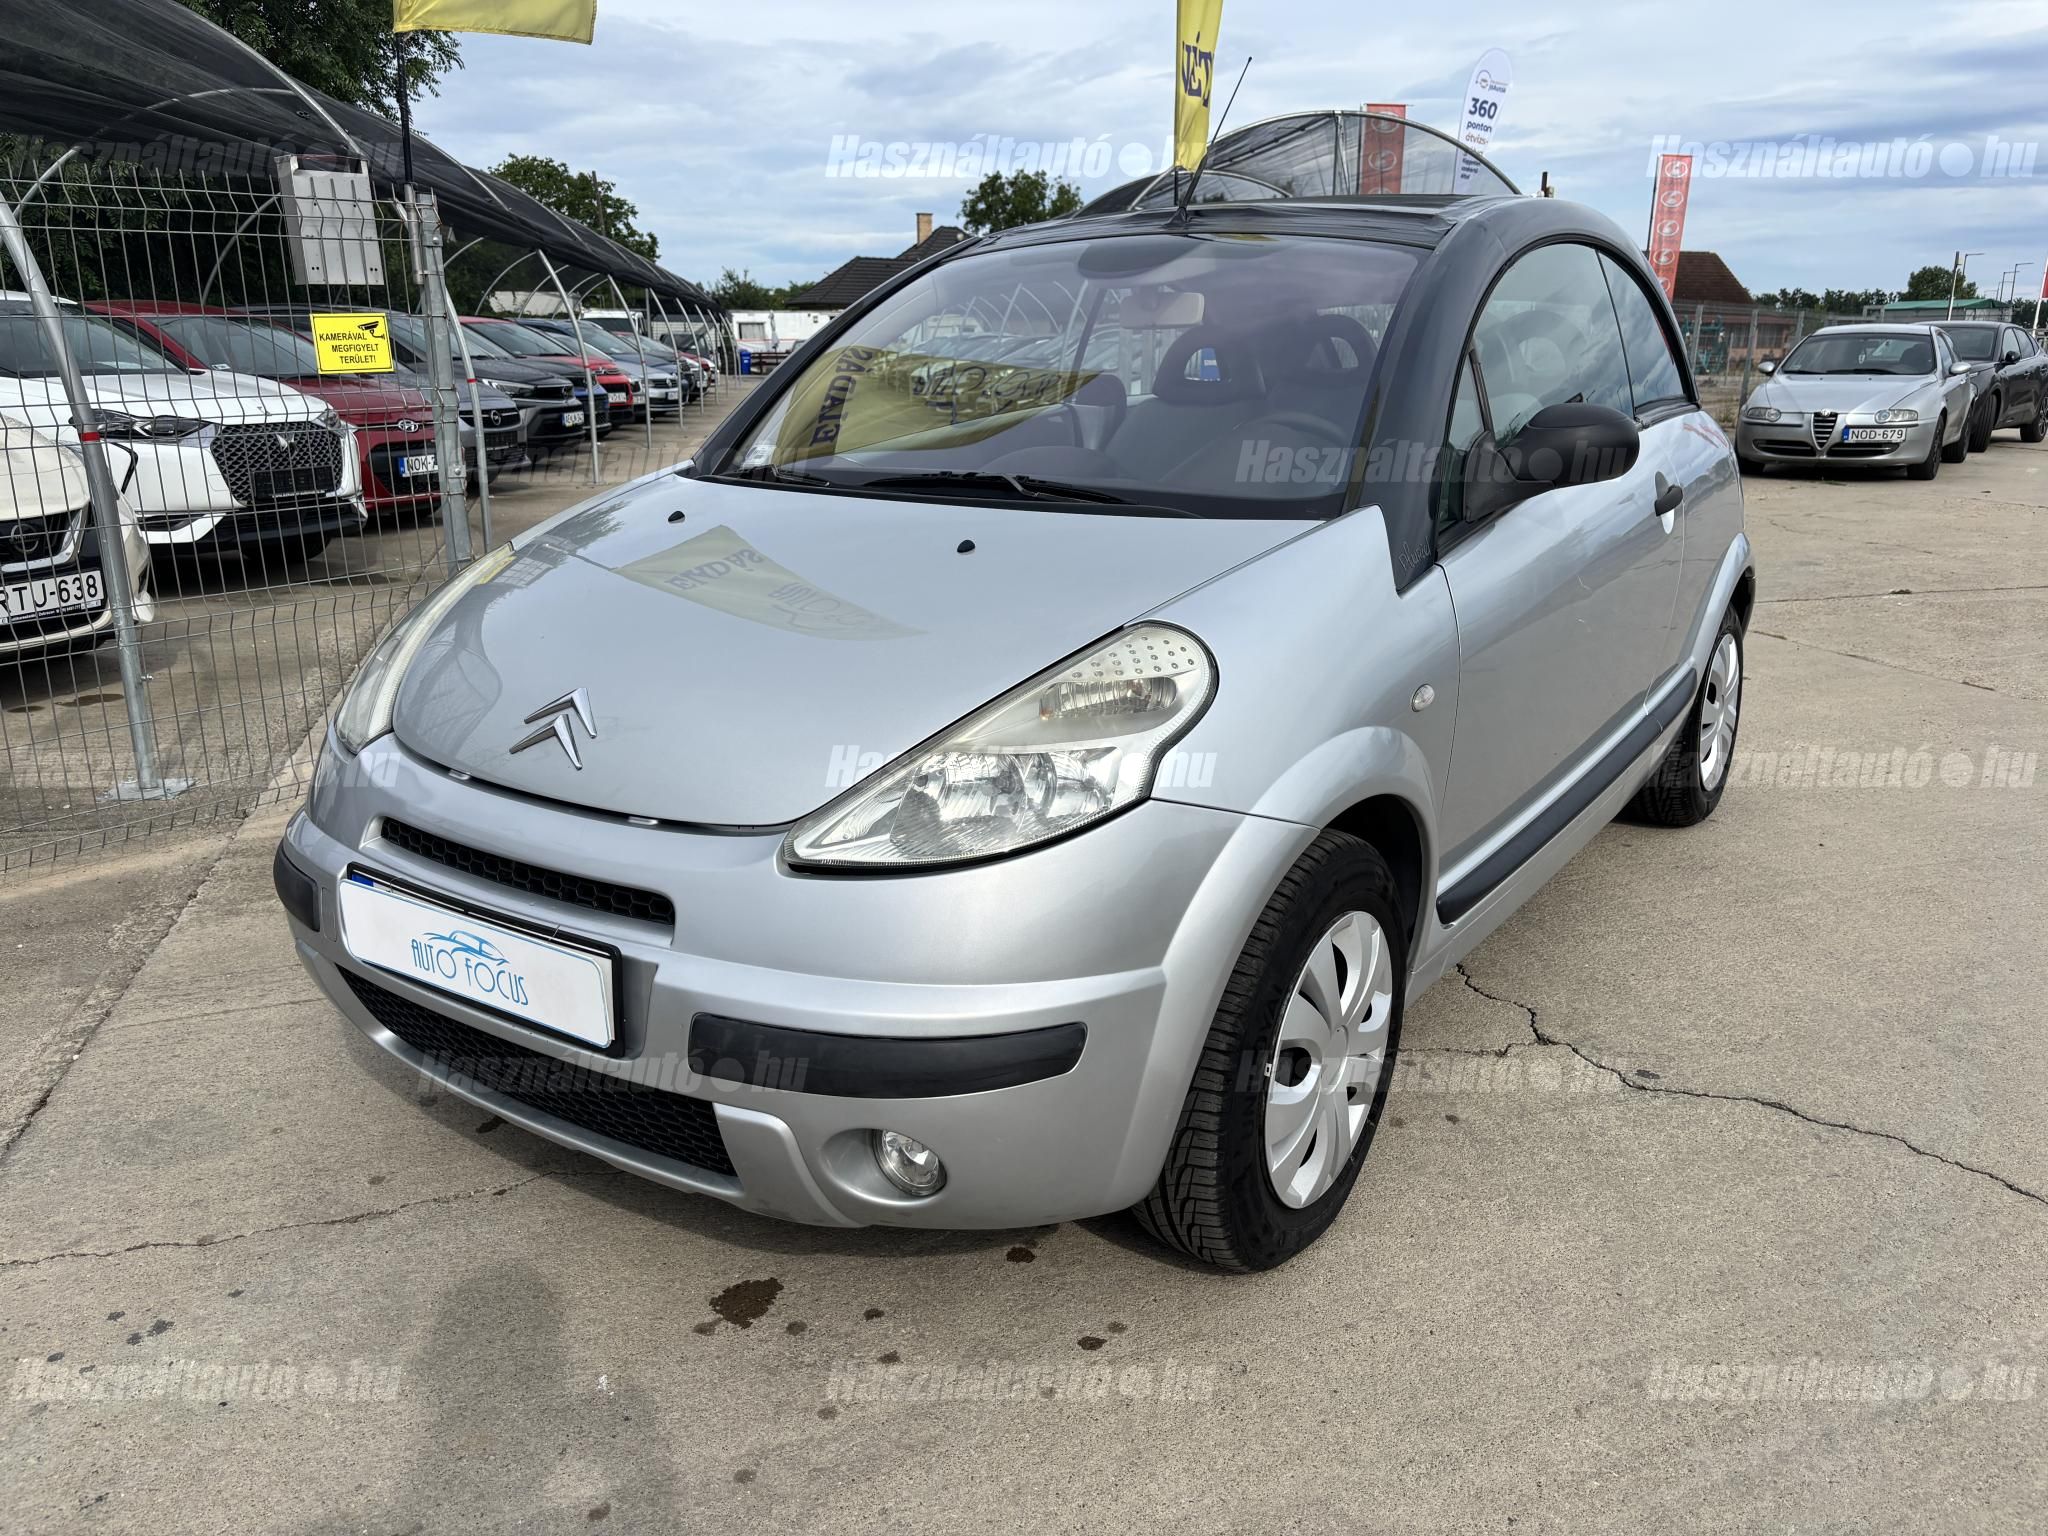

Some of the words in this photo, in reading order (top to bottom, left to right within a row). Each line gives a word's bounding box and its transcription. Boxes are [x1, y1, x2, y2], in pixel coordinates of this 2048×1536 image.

[1468, 97, 1498, 119] 360
[319, 331, 367, 341] KAMERÁVAL
[332, 343, 379, 353] MEGFIGYELT
[340, 354, 376, 364] TERÜLET!
[1851, 429, 1904, 440] NOD-679
[0, 574, 98, 613] RTU-638
[411, 939, 457, 979] AUTO
[465, 957, 529, 1006] FOCUS
